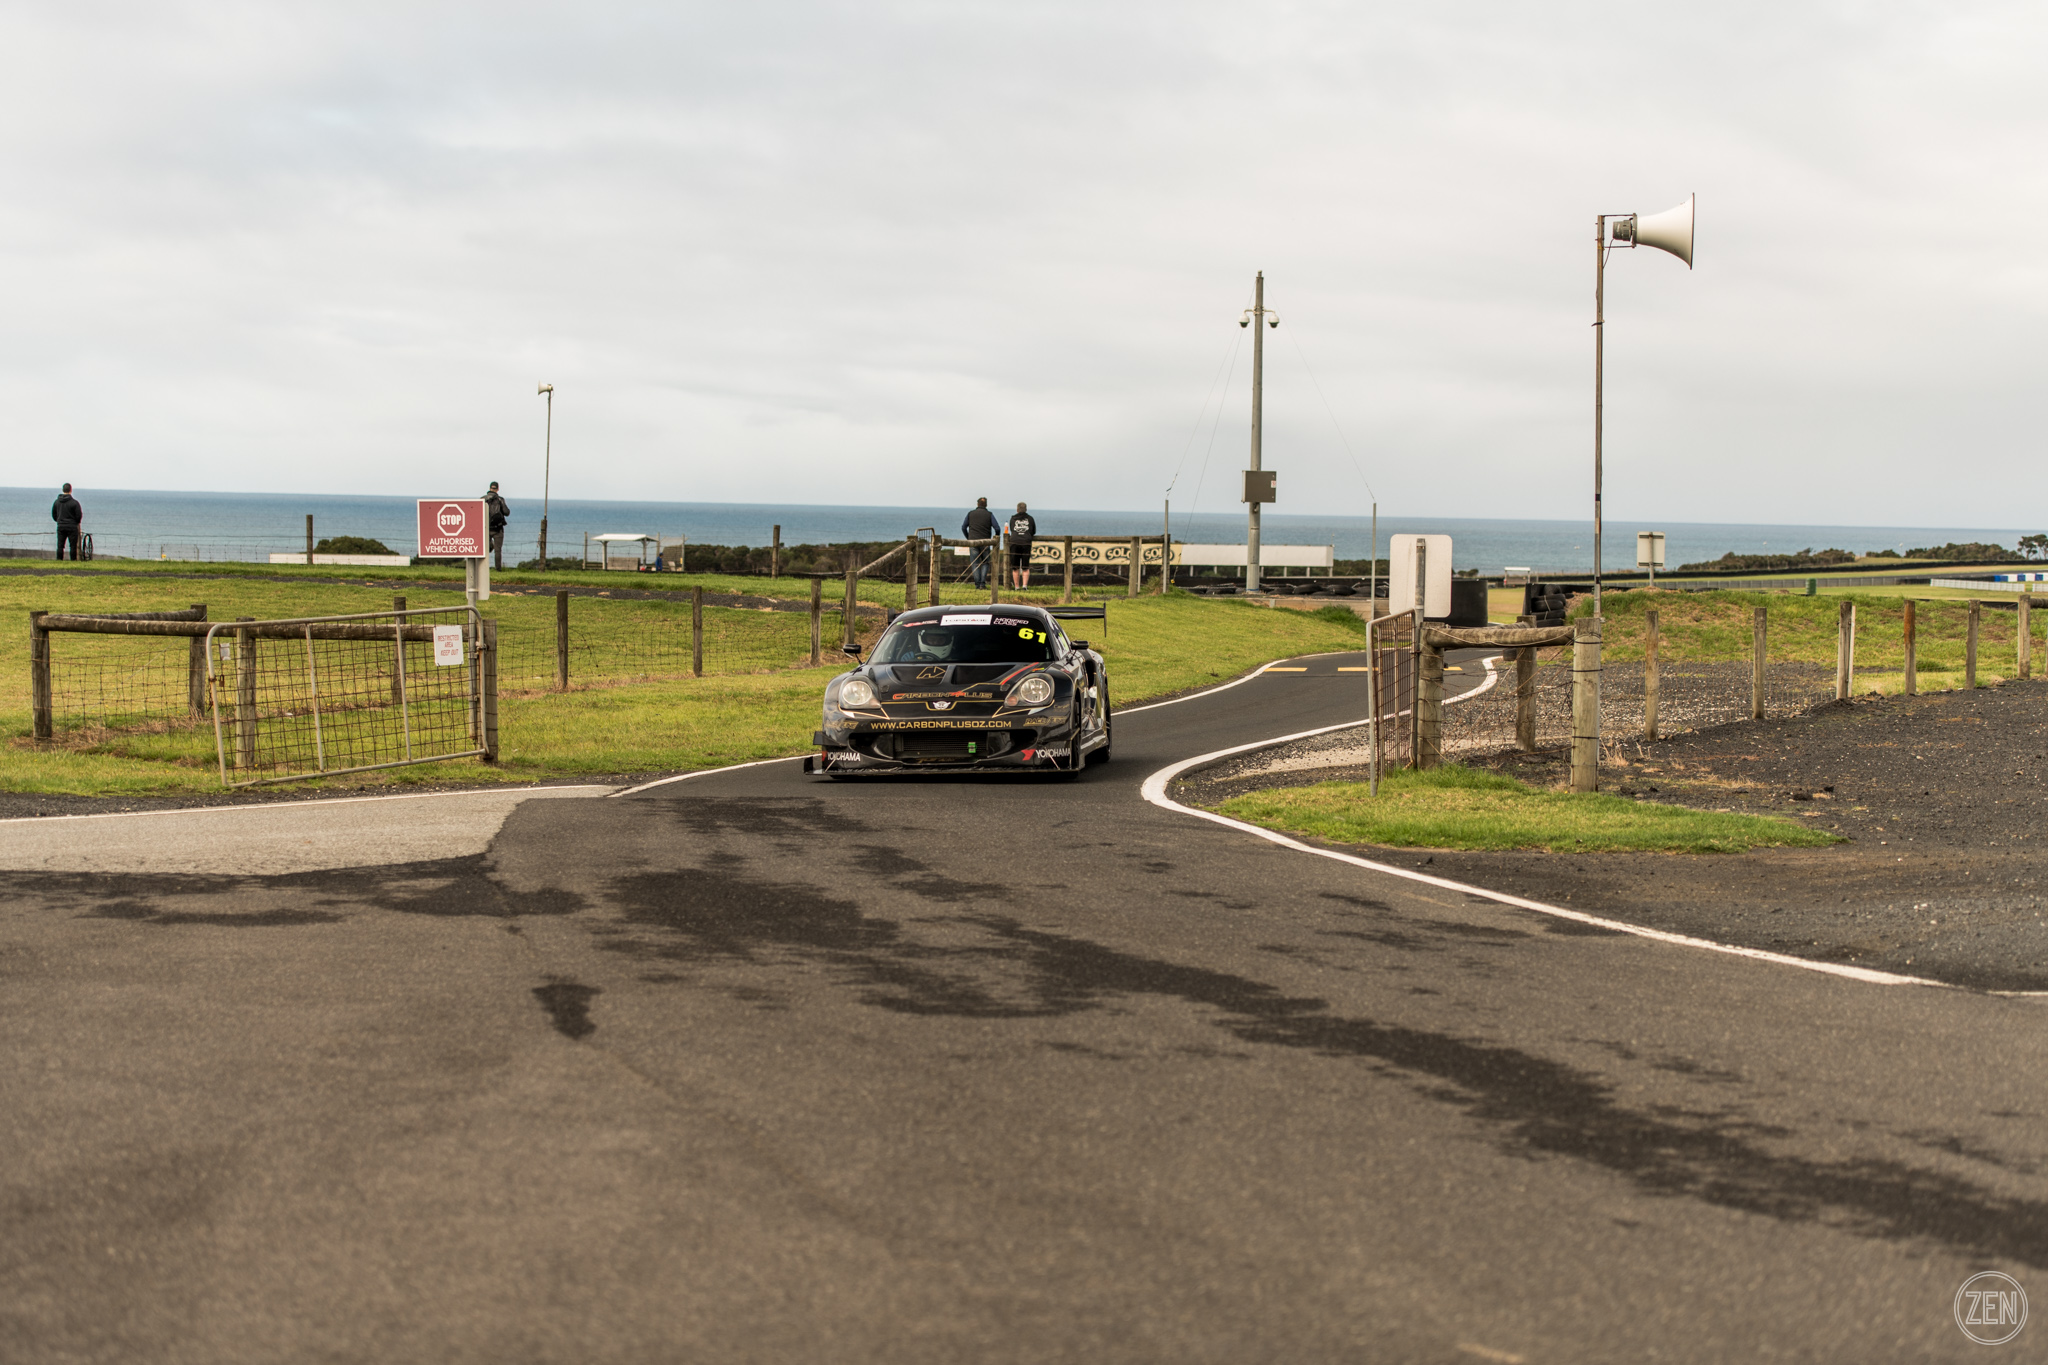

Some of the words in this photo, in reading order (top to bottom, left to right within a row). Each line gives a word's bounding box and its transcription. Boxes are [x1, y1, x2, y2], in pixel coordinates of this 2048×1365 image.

[440, 514, 462, 526] STOP
[429, 537, 475, 546] AUTHORISED
[425, 545, 457, 553] VEHICLES
[458, 545, 479, 553] ONLY
[1031, 546, 1060, 559] SOLO
[437, 634, 460, 642] RESTRICTED
[1018, 627, 1047, 645] 61
[870, 720, 1012, 730] WWW.CARBONPLUSOZ.COM
[827, 751, 861, 761] YOKOHAMA
[1035, 747, 1071, 758] YOKOHAMA
